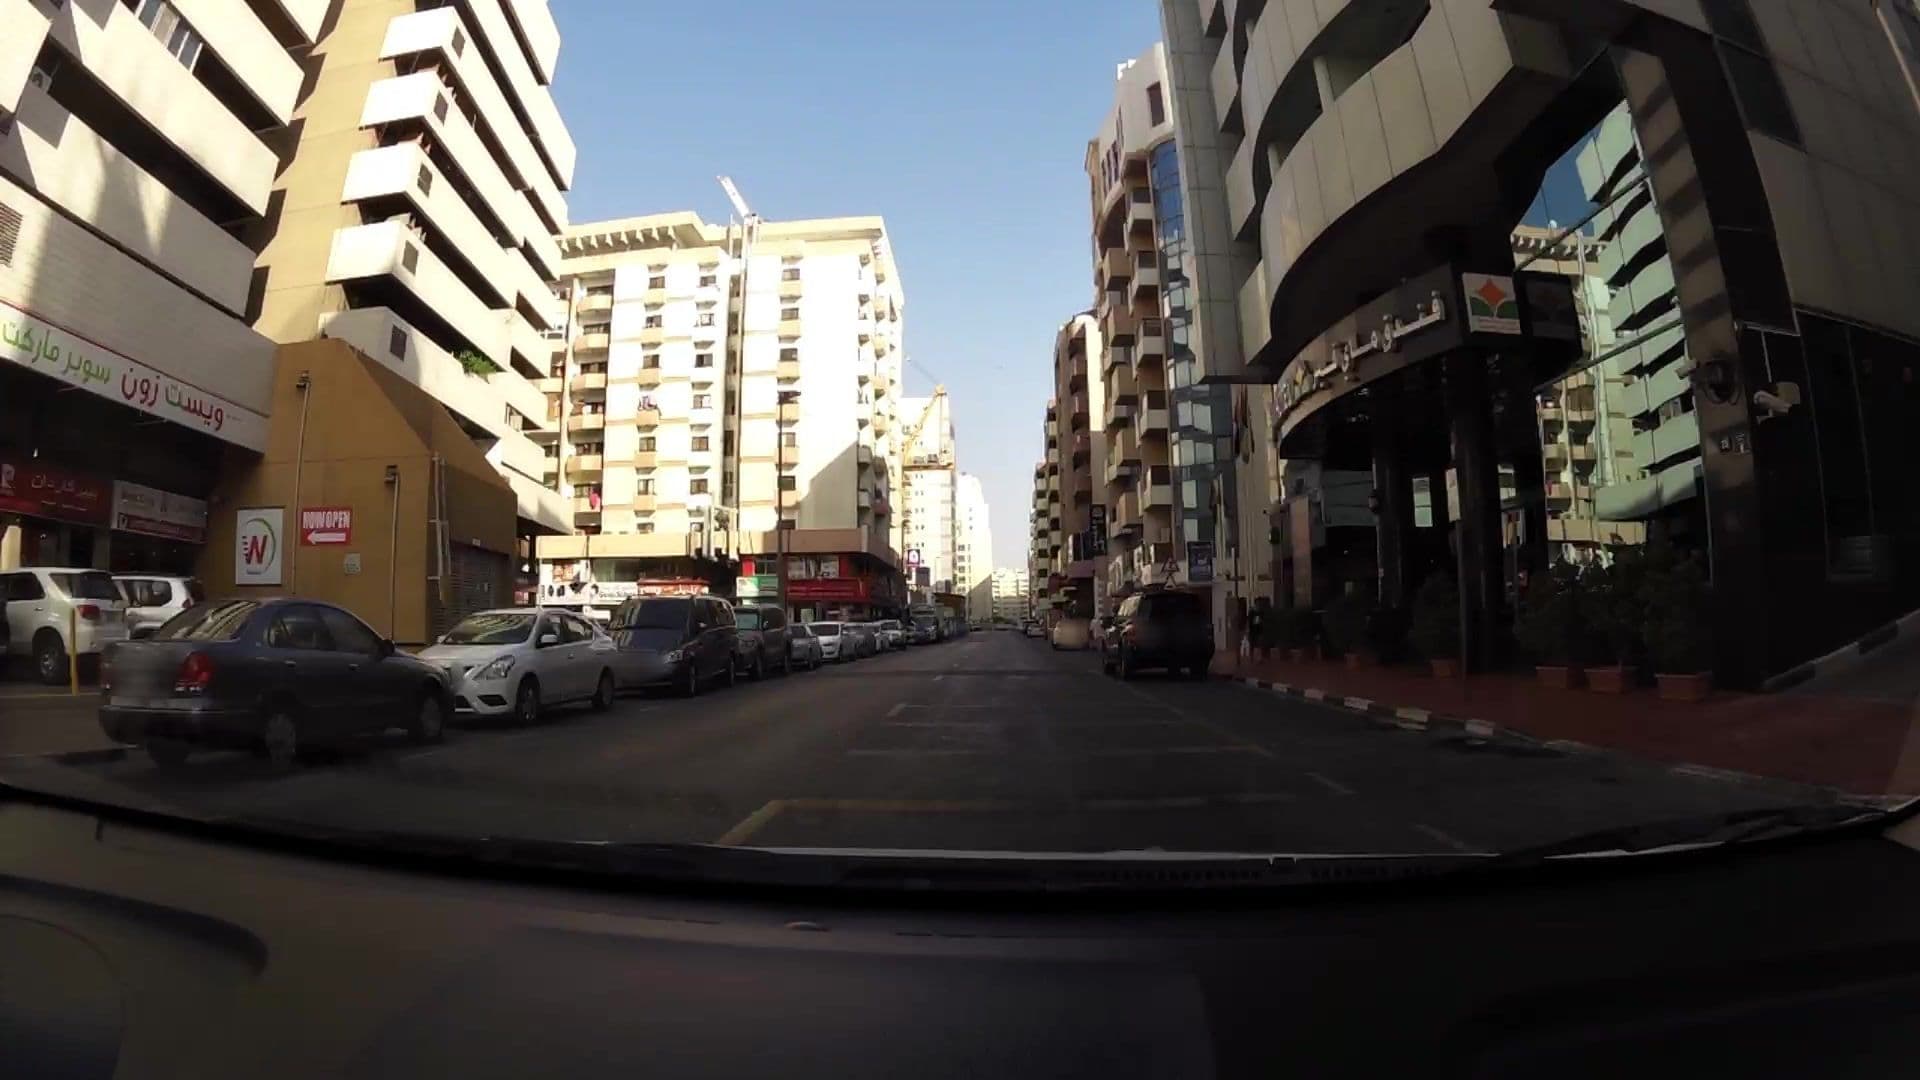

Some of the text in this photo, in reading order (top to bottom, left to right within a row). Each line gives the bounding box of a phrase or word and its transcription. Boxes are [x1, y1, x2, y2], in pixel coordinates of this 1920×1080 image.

[1382, 289, 1446, 353] فندق
[2, 321, 224, 431] ويست زون سوبر ماركت
[302, 511, 351, 529] NOW OPEN
